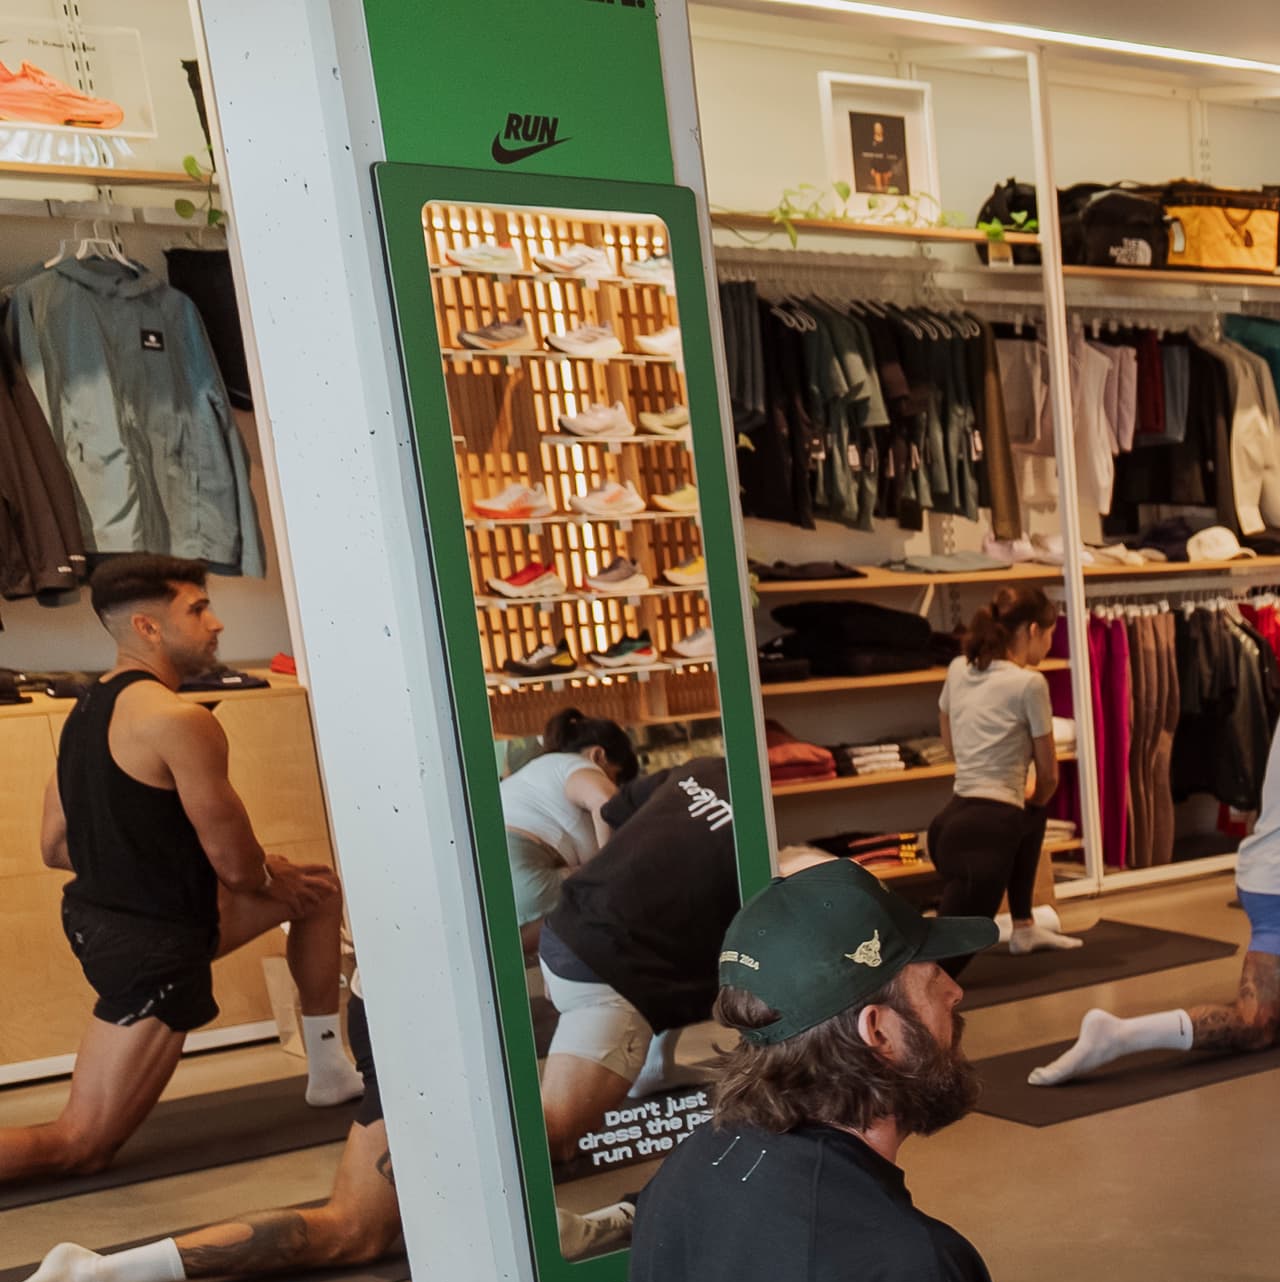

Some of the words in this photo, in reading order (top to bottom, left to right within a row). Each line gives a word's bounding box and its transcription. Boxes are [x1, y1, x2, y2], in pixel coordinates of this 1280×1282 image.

[504, 112, 559, 144] RUN
[604, 1102, 661, 1127] Don't
[664, 1091, 708, 1118] just
[578, 1125, 642, 1151] dress
[646, 1117, 683, 1135] the
[592, 1145, 633, 1166] run
[636, 1136, 673, 1156] the
